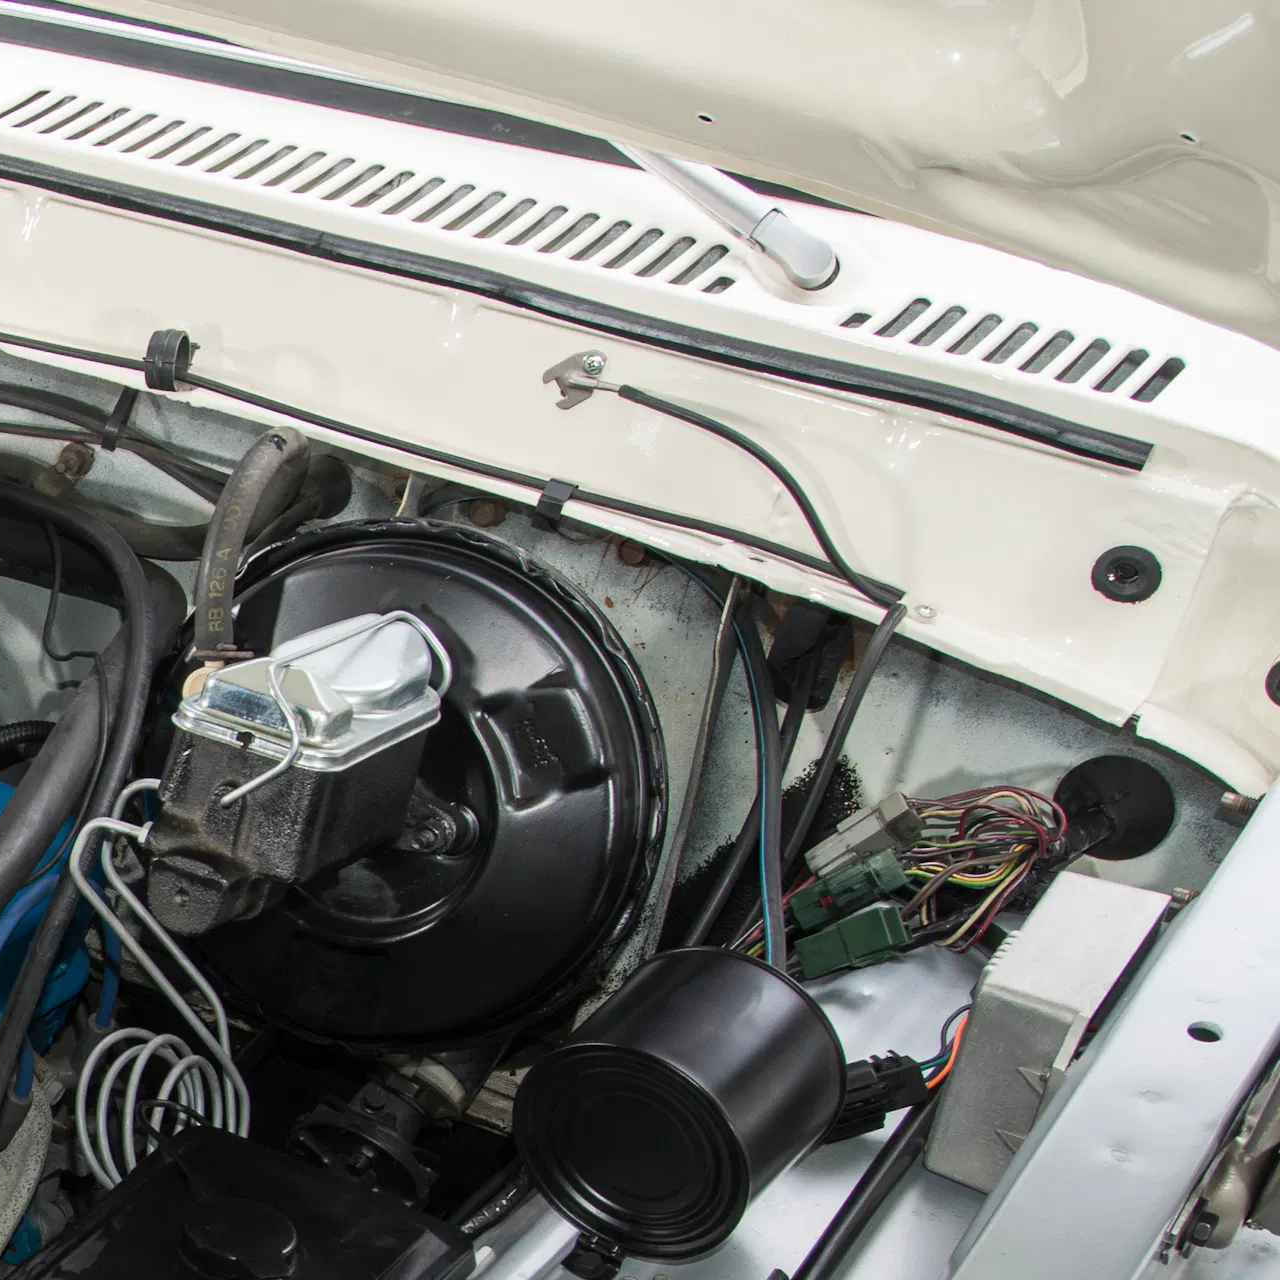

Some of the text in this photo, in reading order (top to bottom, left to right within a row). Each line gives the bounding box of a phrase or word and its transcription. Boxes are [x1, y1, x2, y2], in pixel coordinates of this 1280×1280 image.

[216, 548, 232, 561] A
[209, 567, 227, 599] 126
[208, 608, 224, 632] RB
